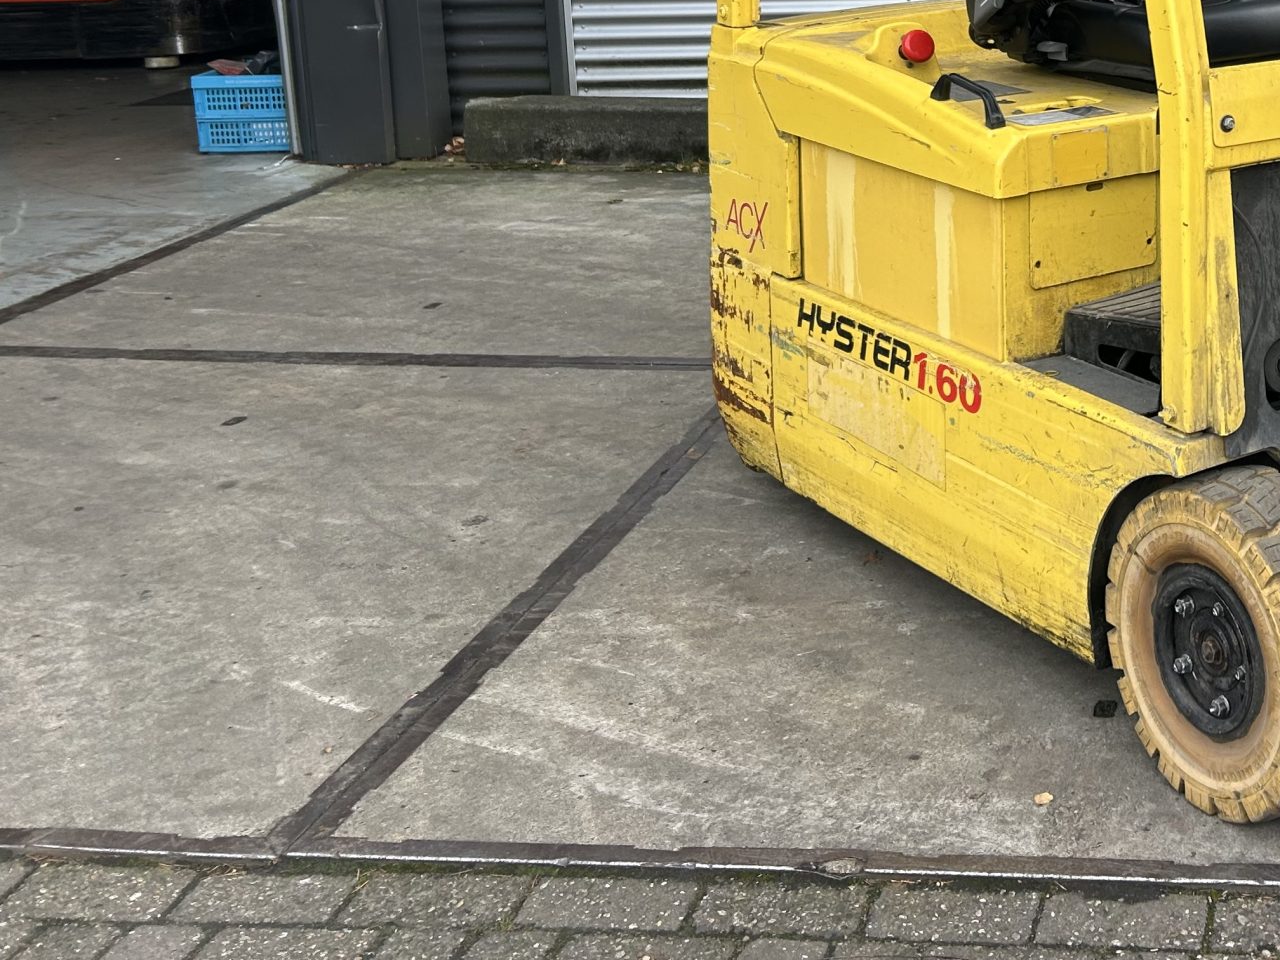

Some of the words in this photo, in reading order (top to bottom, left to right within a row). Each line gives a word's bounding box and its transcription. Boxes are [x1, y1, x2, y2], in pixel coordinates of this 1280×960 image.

[725, 198, 768, 253] ACX
[797, 297, 912, 381] HYSTER
[913, 351, 983, 414] 1.60
